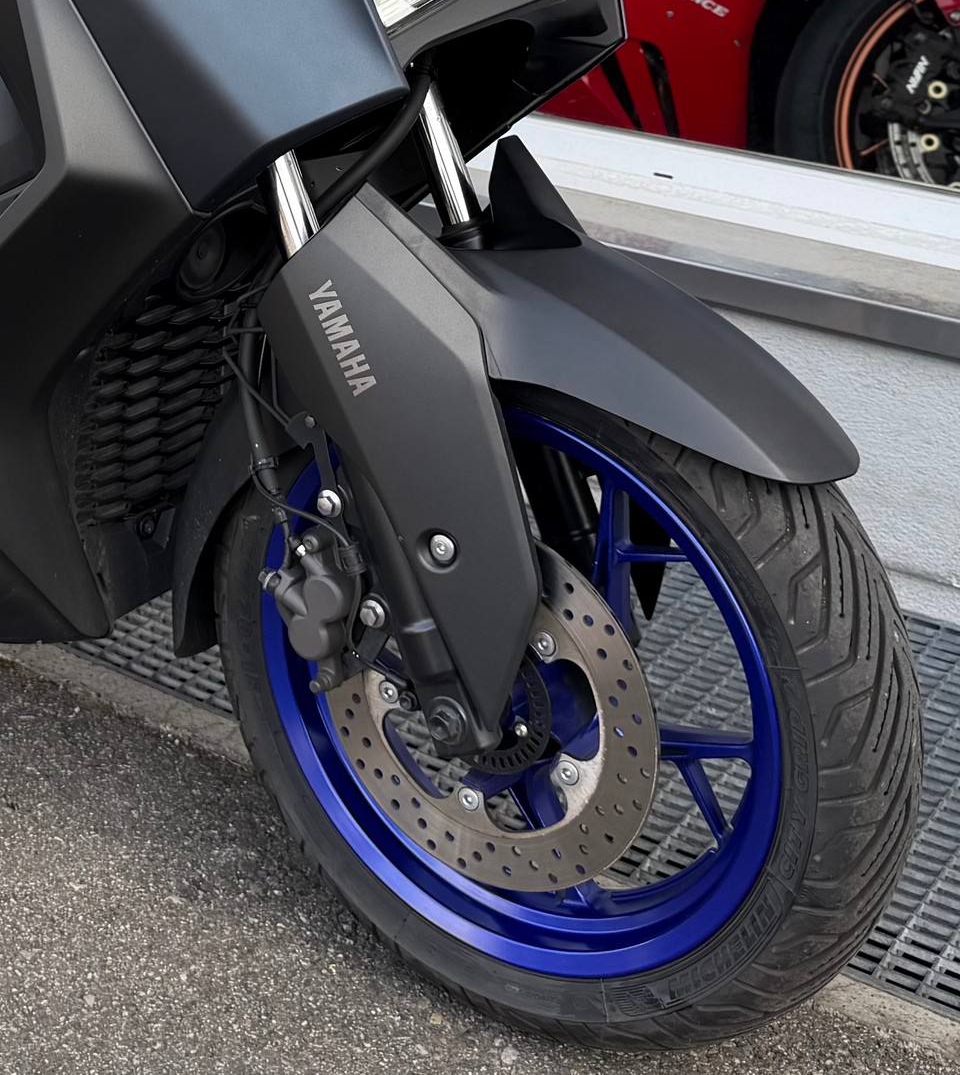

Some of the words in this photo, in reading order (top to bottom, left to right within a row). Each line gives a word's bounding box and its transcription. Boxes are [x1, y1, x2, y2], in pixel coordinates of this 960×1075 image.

[308, 279, 378, 397] YAMAHA
[790, 708, 809, 793] GRIP
[779, 795, 807, 880] CITY
